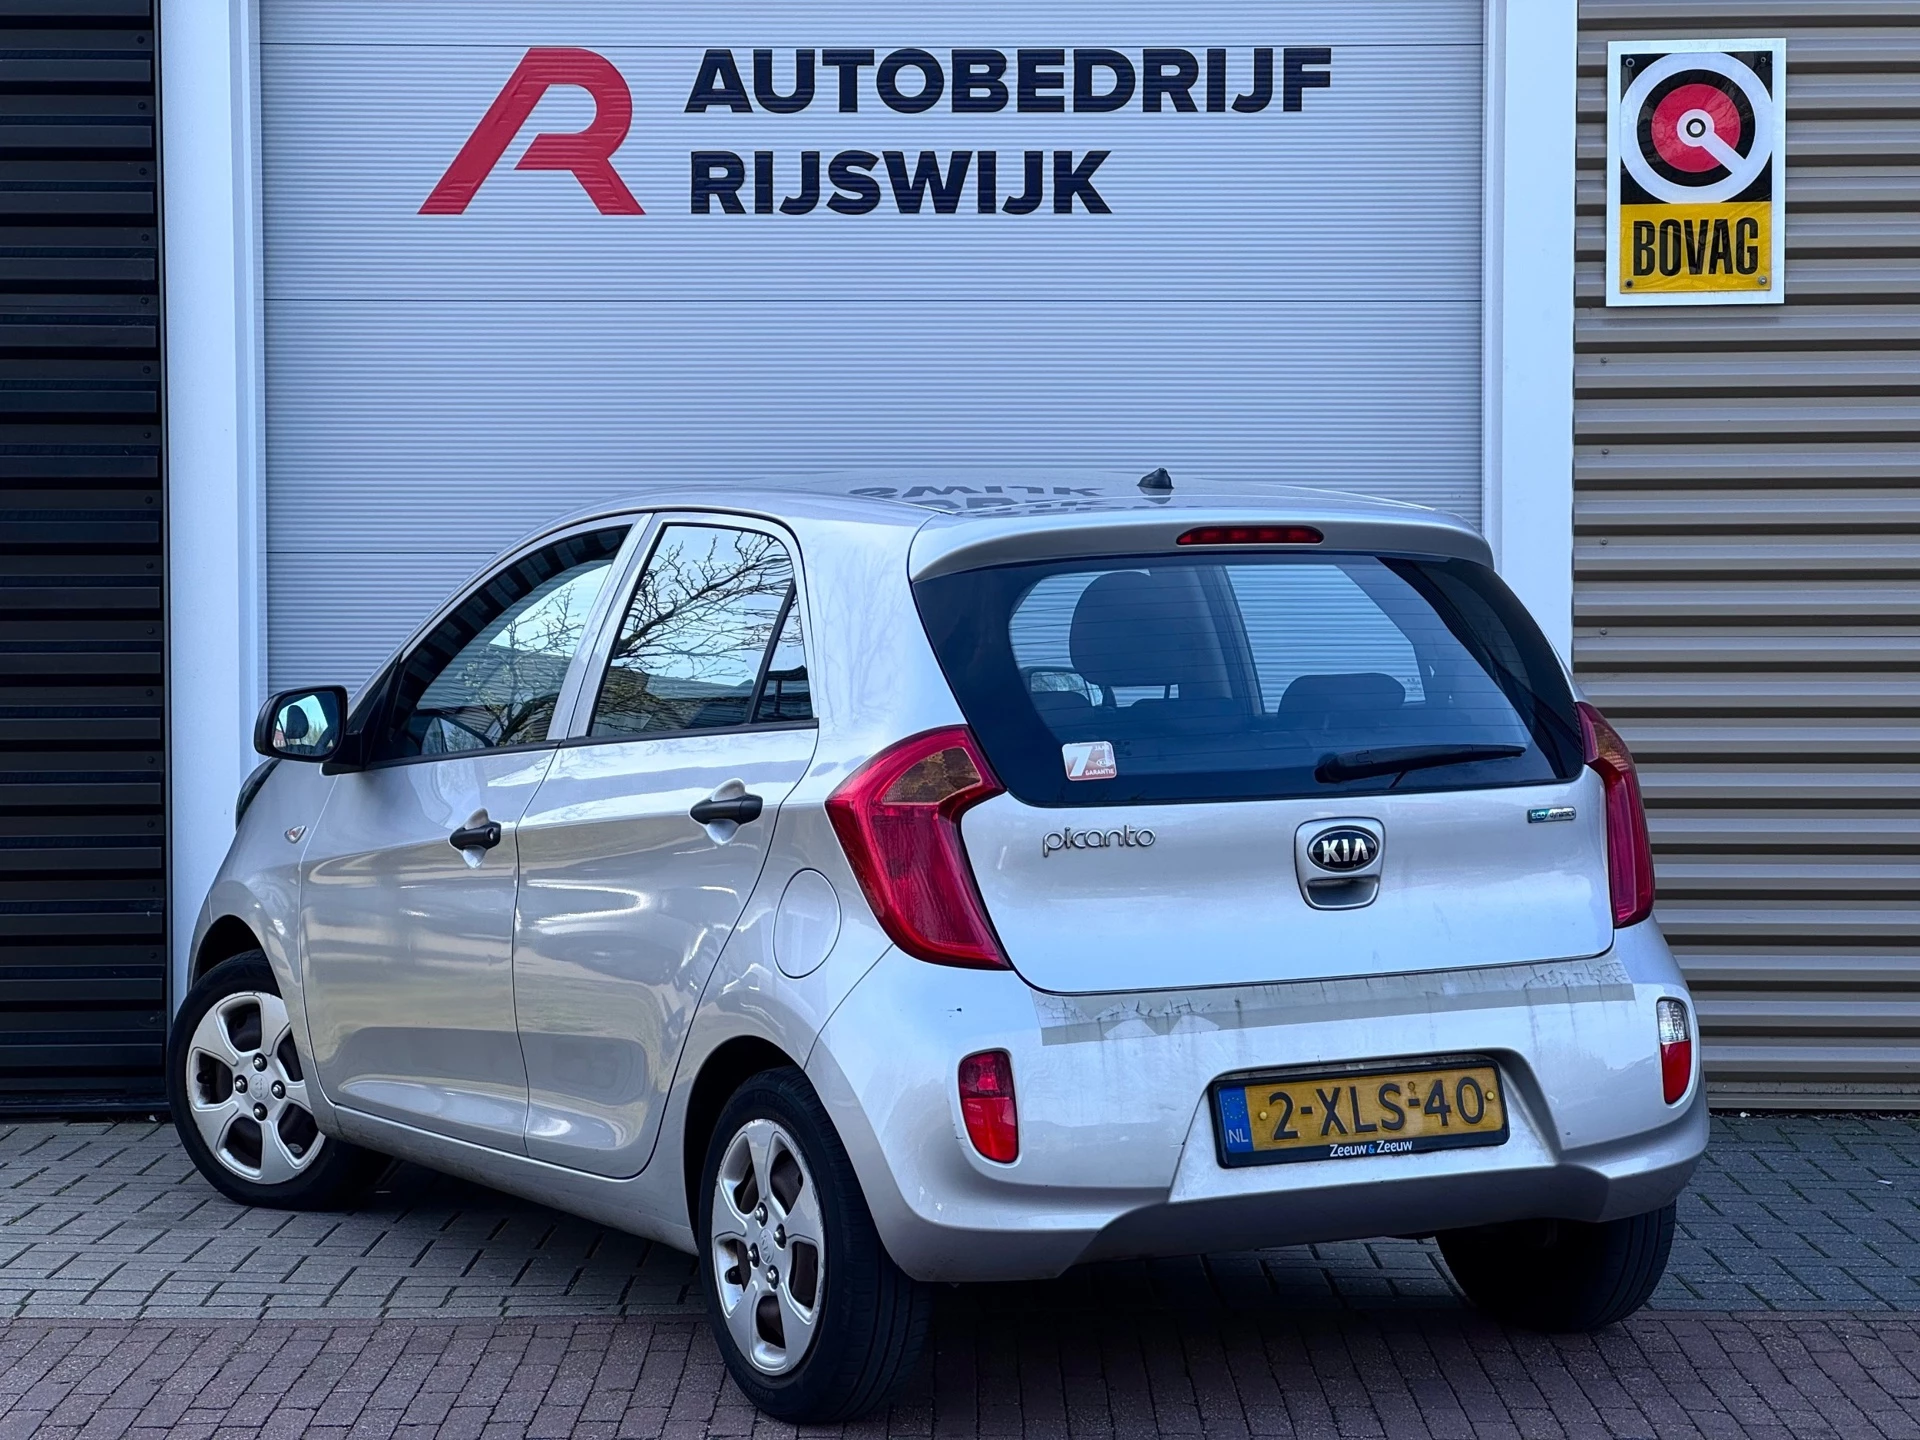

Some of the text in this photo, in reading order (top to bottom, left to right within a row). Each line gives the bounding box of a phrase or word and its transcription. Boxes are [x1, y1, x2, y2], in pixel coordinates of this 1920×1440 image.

[685, 48, 1331, 113] AUTOBEDRIJF
[690, 150, 1113, 215] RIJSWIJK
[1633, 217, 1758, 276] BOVAG
[1085, 768, 1115, 776] GARANTIE
[1043, 825, 1156, 858] picanto
[1321, 838, 1370, 863] KIA
[1268, 1076, 1485, 1141] 2-XLS-40
[1228, 1129, 1249, 1144] NL
[1330, 1144, 1367, 1157] Zeeuw
[1376, 1140, 1412, 1153] Zeeuw
